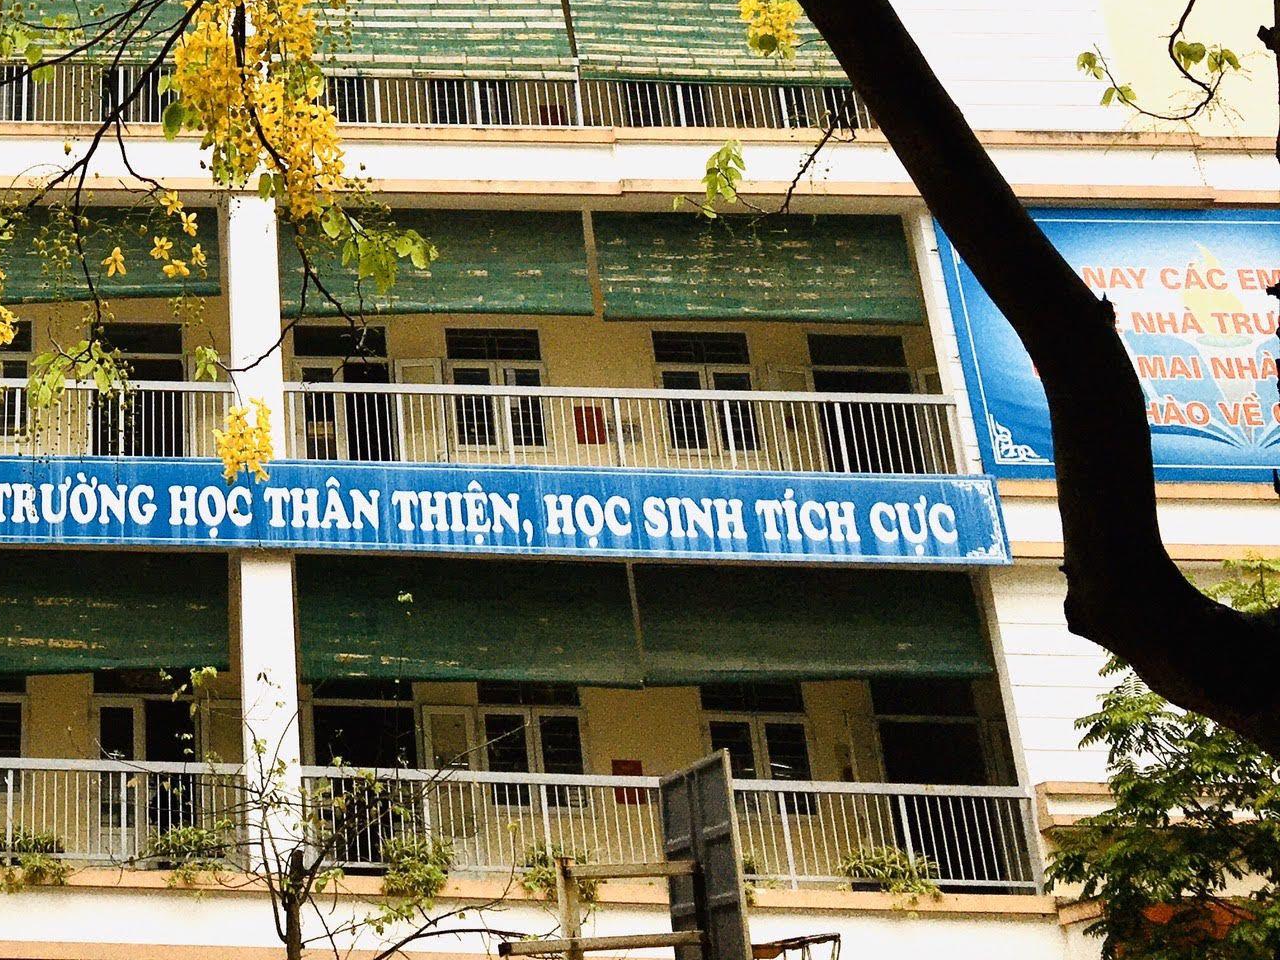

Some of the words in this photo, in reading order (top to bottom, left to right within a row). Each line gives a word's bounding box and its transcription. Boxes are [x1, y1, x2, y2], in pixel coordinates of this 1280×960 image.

[1082, 267, 1147, 289] NAY
[1160, 262, 1228, 290] CÁC
[1236, 269, 1280, 290] EM
[1131, 306, 1204, 334] NHÀ
[1211, 310, 1280, 335] TRƯ
[1137, 356, 1203, 379] MAI
[1210, 351, 1278, 379] NHÀ
[1218, 392, 1264, 426] VỀ
[169, 484, 253, 538] HỌC
[264, 477, 380, 530] THÂN
[392, 480, 533, 544] THIỆN,
[543, 494, 632, 549] HỌC
[643, 495, 747, 540] SINH
[756, 488, 861, 543] TÍCH
[870, 495, 959, 555] CỰC
